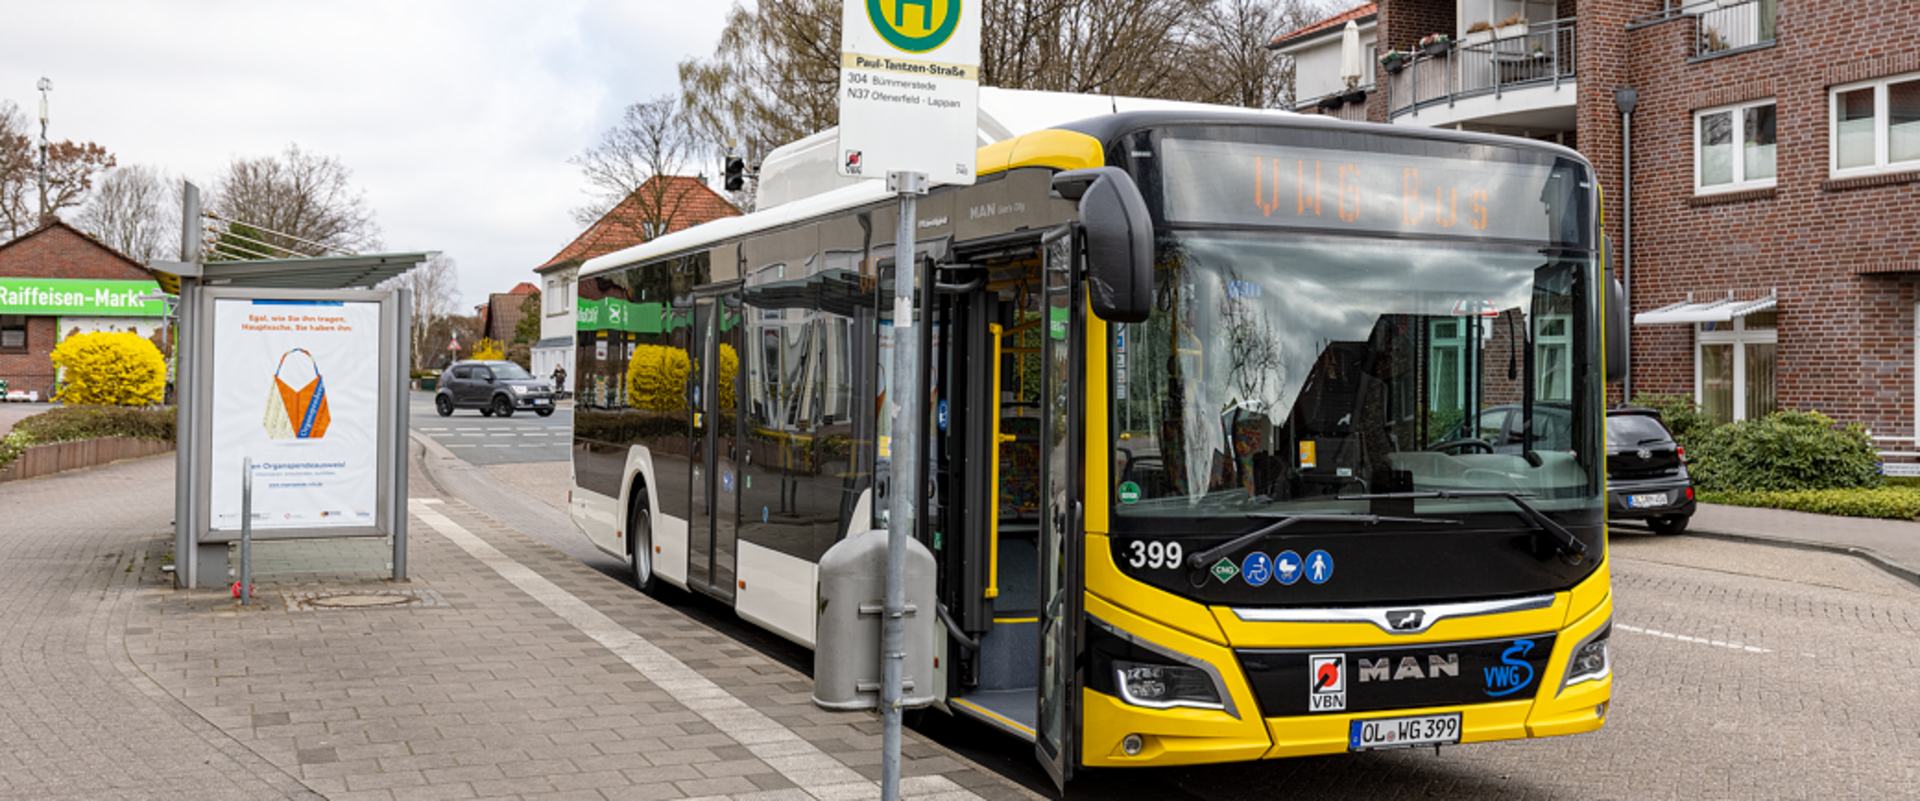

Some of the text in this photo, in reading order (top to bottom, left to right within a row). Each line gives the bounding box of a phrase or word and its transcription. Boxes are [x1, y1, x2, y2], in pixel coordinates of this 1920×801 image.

[856, 57, 965, 77] Paul-Tantzen-Straße
[847, 72, 937, 91] 304 Bümmerstede
[847, 88, 870, 99] N37
[871, 91, 920, 104] Ofenerfeld
[928, 96, 961, 109] Lappan
[1255, 156, 1488, 230] VWG Bus
[970, 203, 996, 219] MAN
[0, 286, 145, 307] Raiffeisen-Markt
[1129, 540, 1182, 569] 399
[1216, 565, 1234, 575] CNG
[1358, 653, 1459, 682] MAN
[1484, 666, 1519, 687] VWG
[1312, 694, 1344, 709] VBN
[1363, 718, 1457, 743] OL WG 399
